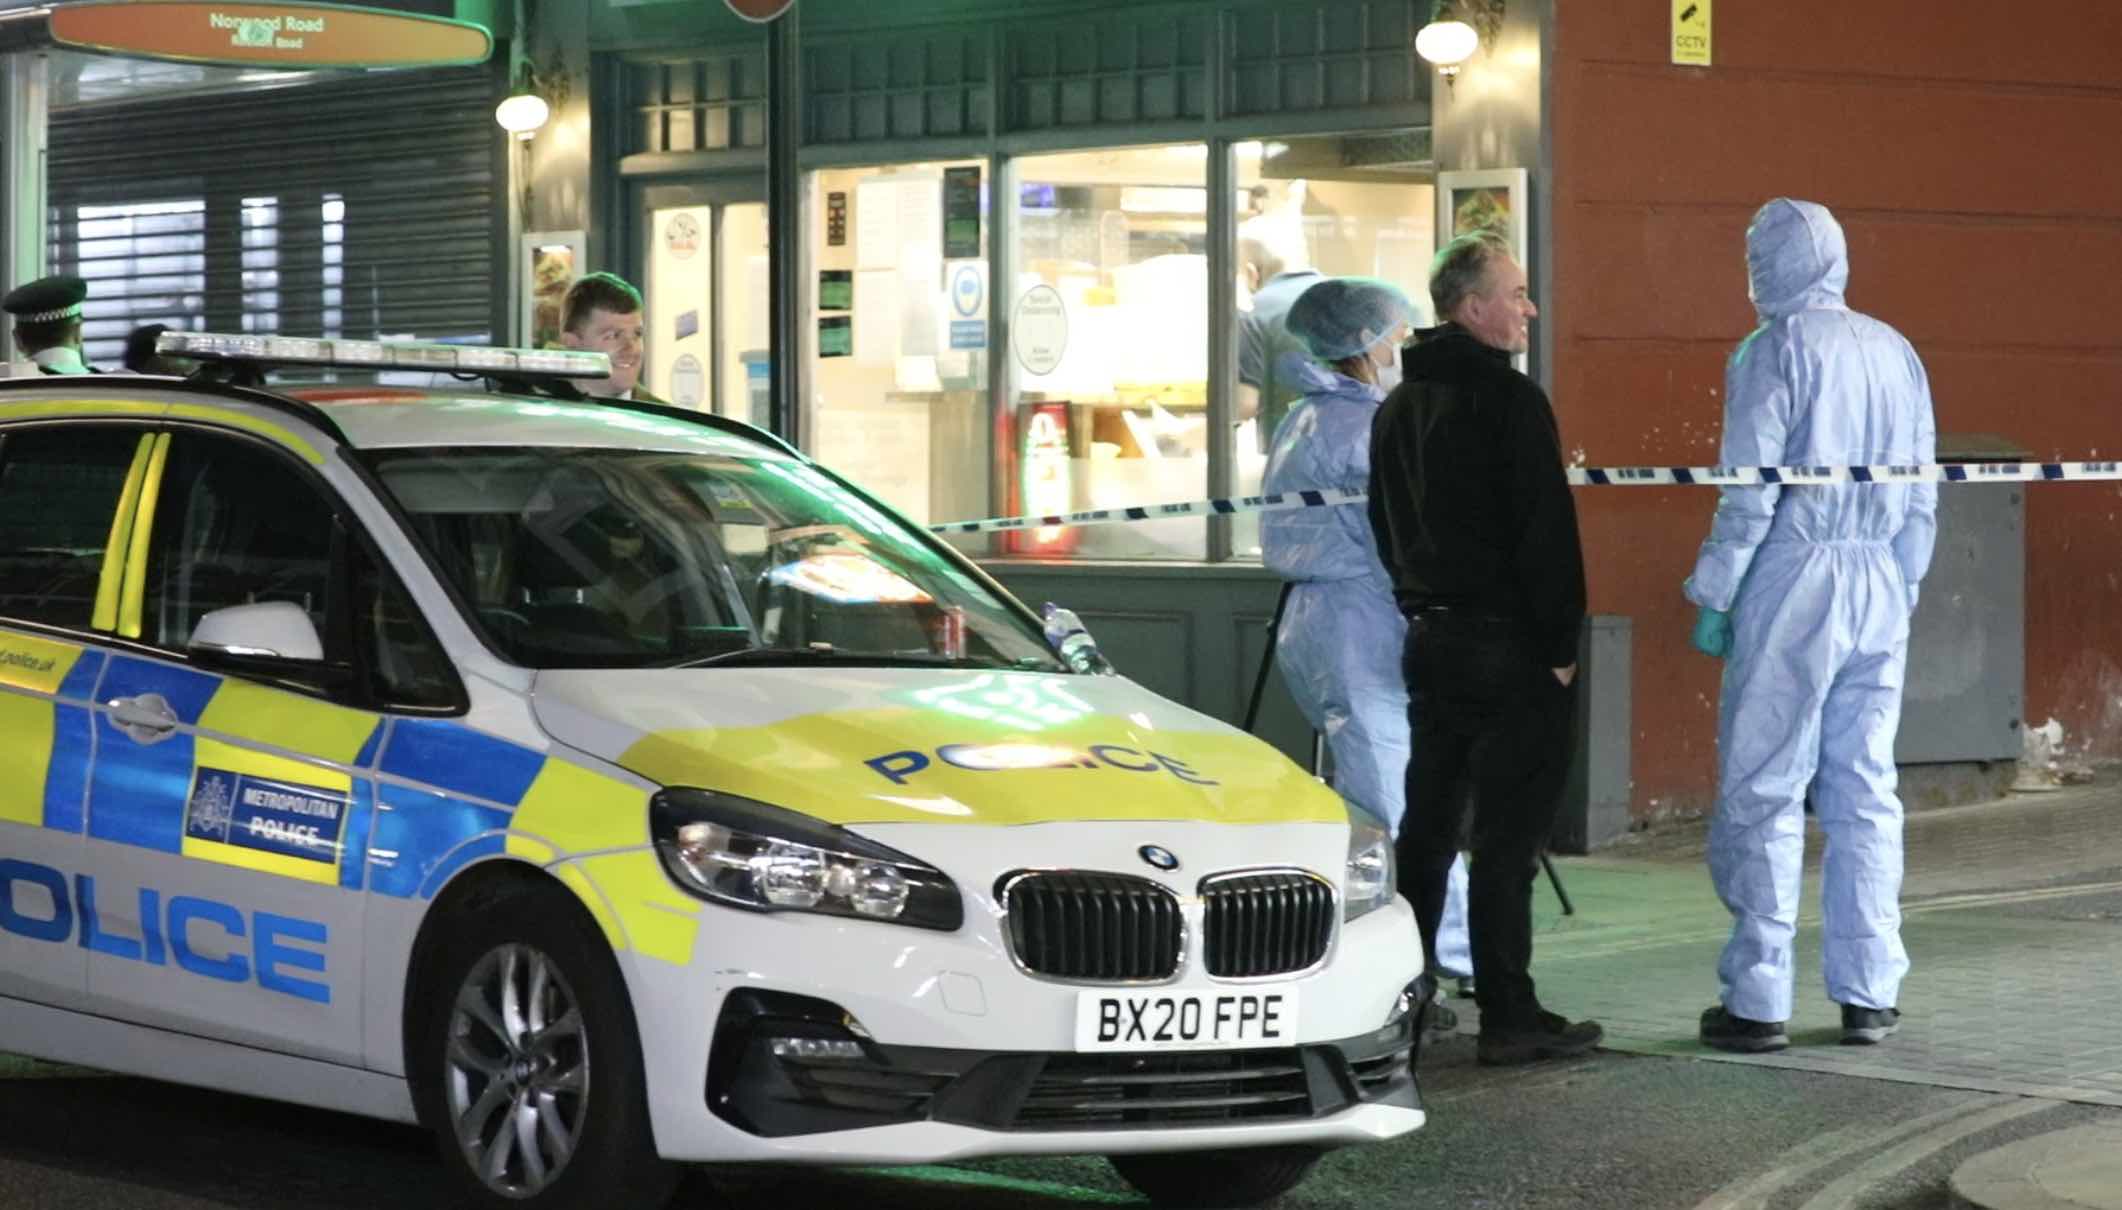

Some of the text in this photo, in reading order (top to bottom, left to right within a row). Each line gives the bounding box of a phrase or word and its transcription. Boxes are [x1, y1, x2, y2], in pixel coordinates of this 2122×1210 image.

[286, 15, 323, 32] Road
[1676, 35, 1706, 48] CCTV
[242, 786, 339, 820] METROPOLITAN
[251, 815, 320, 849] POLICE
[1098, 995, 1283, 1042] BX20 FPE
